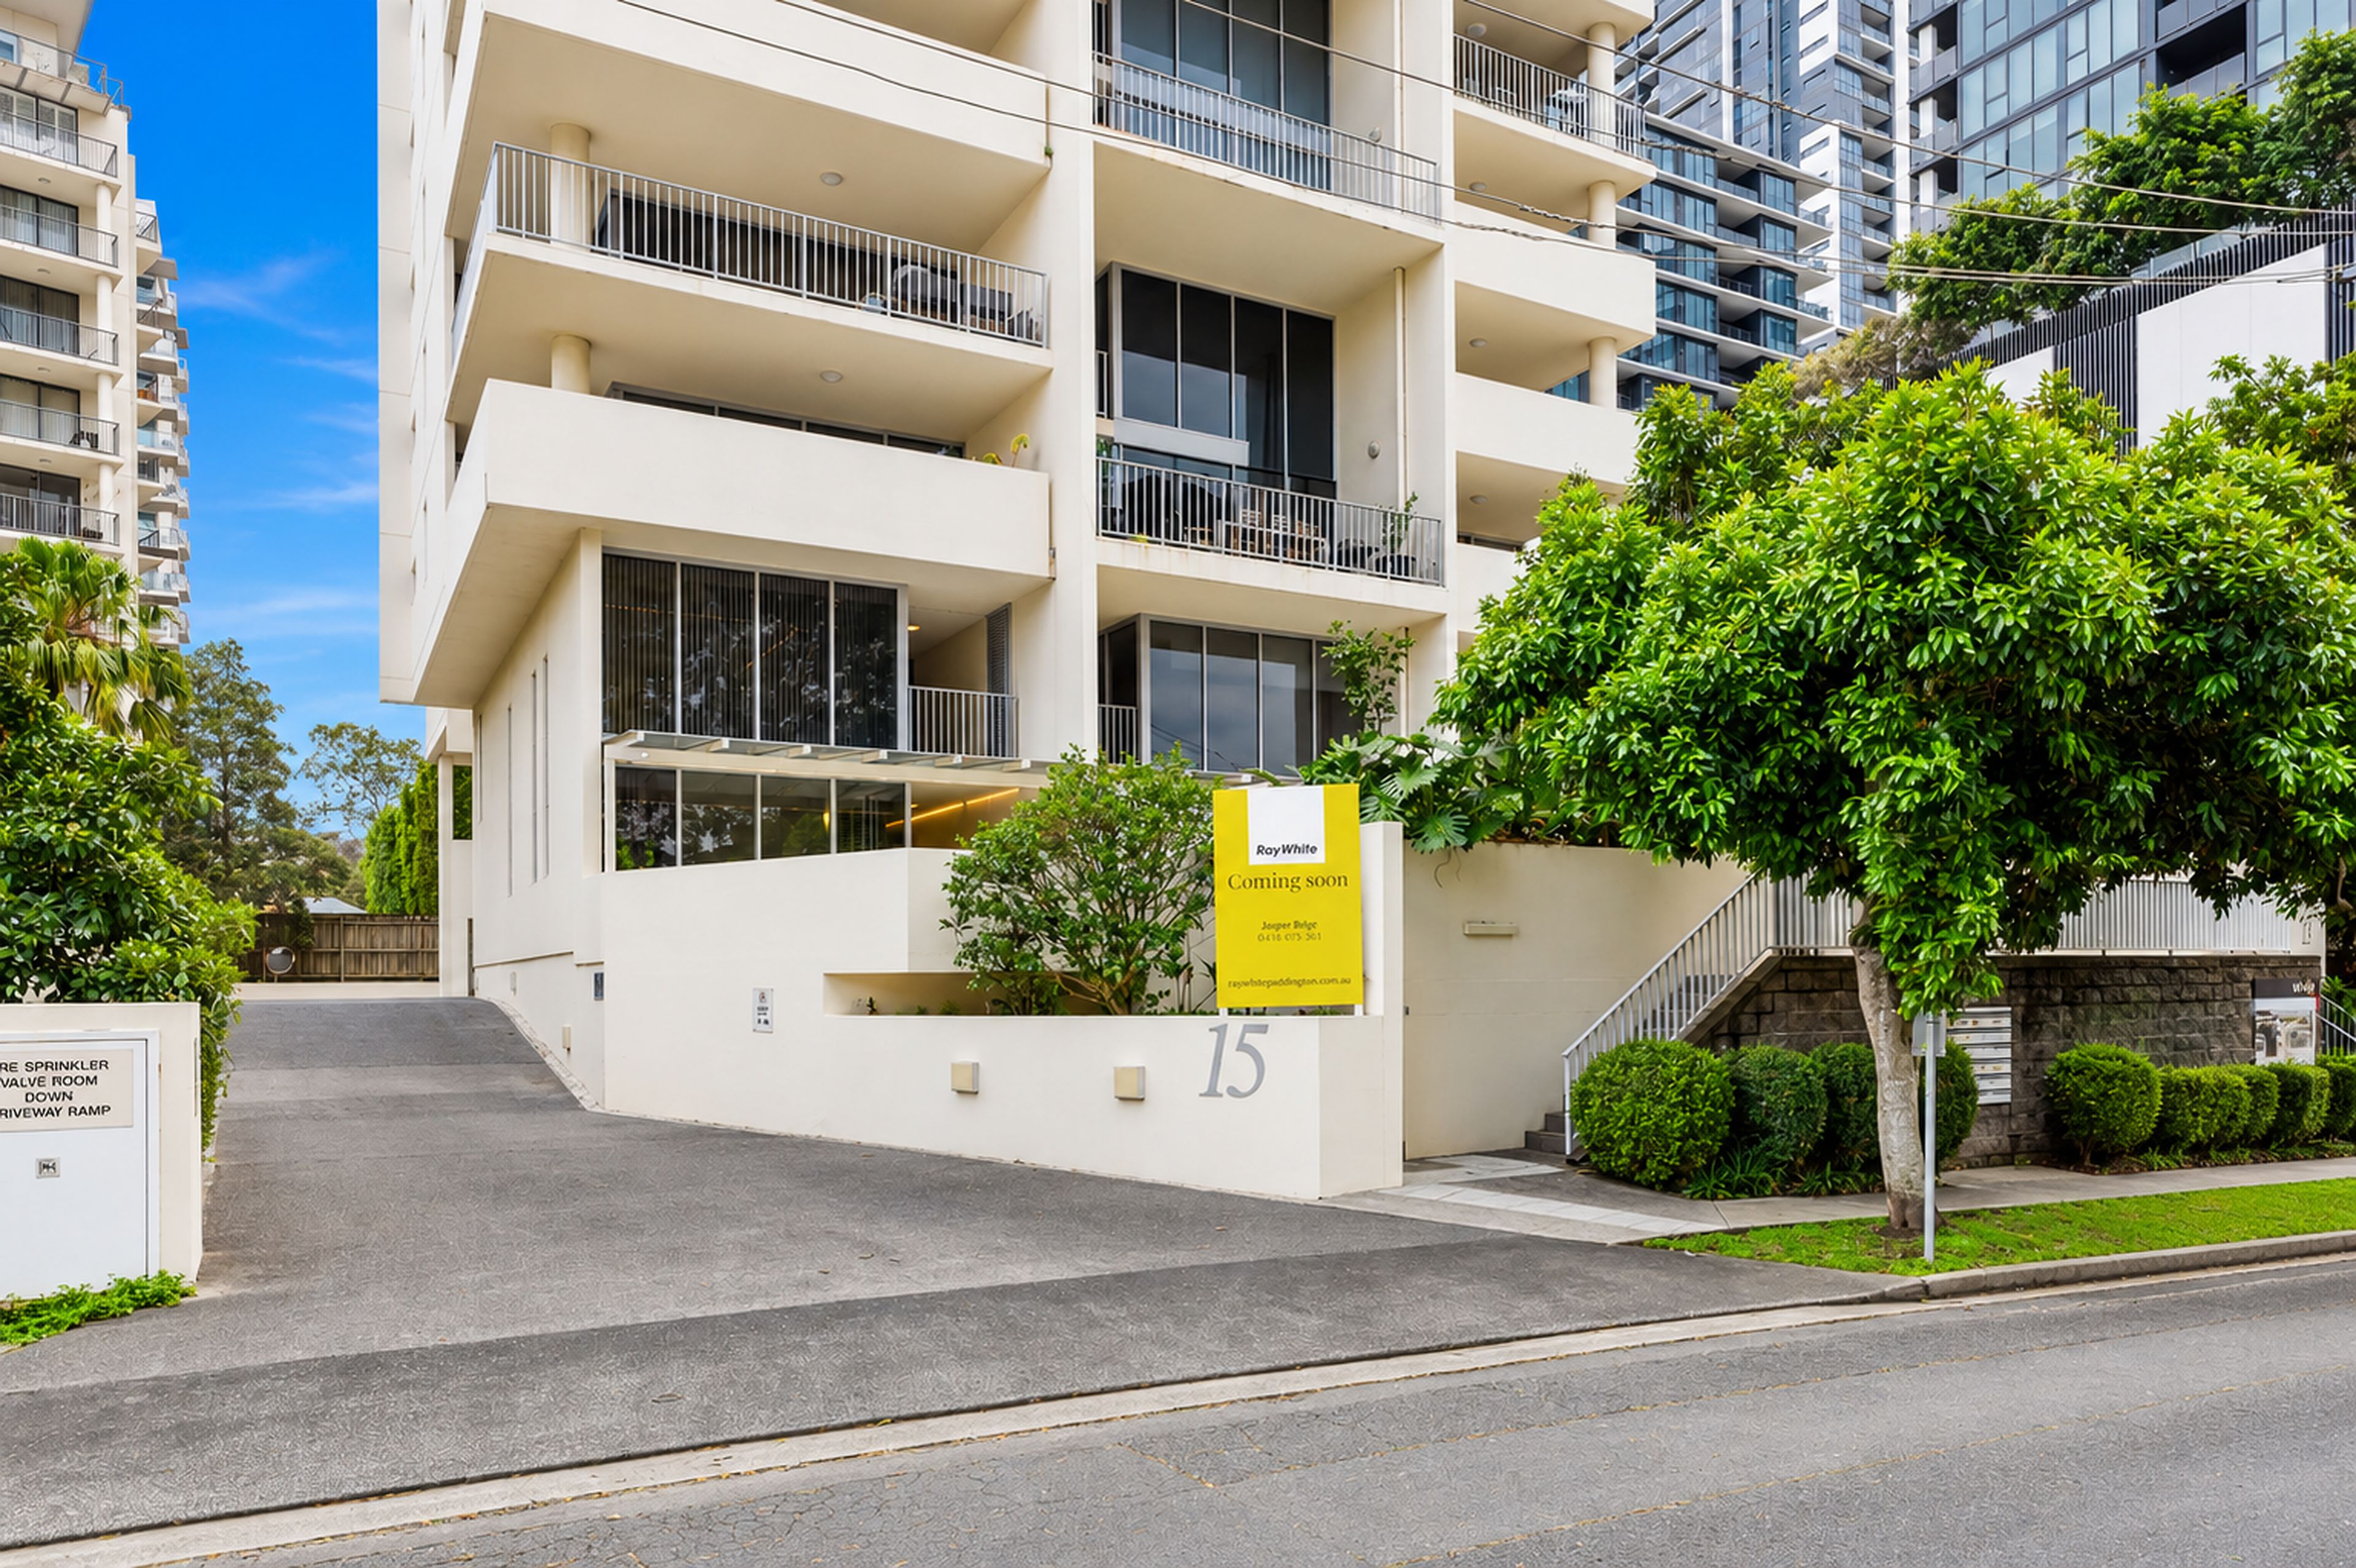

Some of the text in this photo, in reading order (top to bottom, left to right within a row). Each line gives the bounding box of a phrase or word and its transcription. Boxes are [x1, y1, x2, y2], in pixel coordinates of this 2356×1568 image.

[1228, 872, 1348, 893] Coming soon
[25, 1059, 109, 1072] SPRINKLER
[1198, 1023, 1269, 1099] 15
[0, 1075, 98, 1088] VALVE ROOM
[25, 1091, 73, 1103] DOWN
[68, 1105, 111, 1116] RAMP
